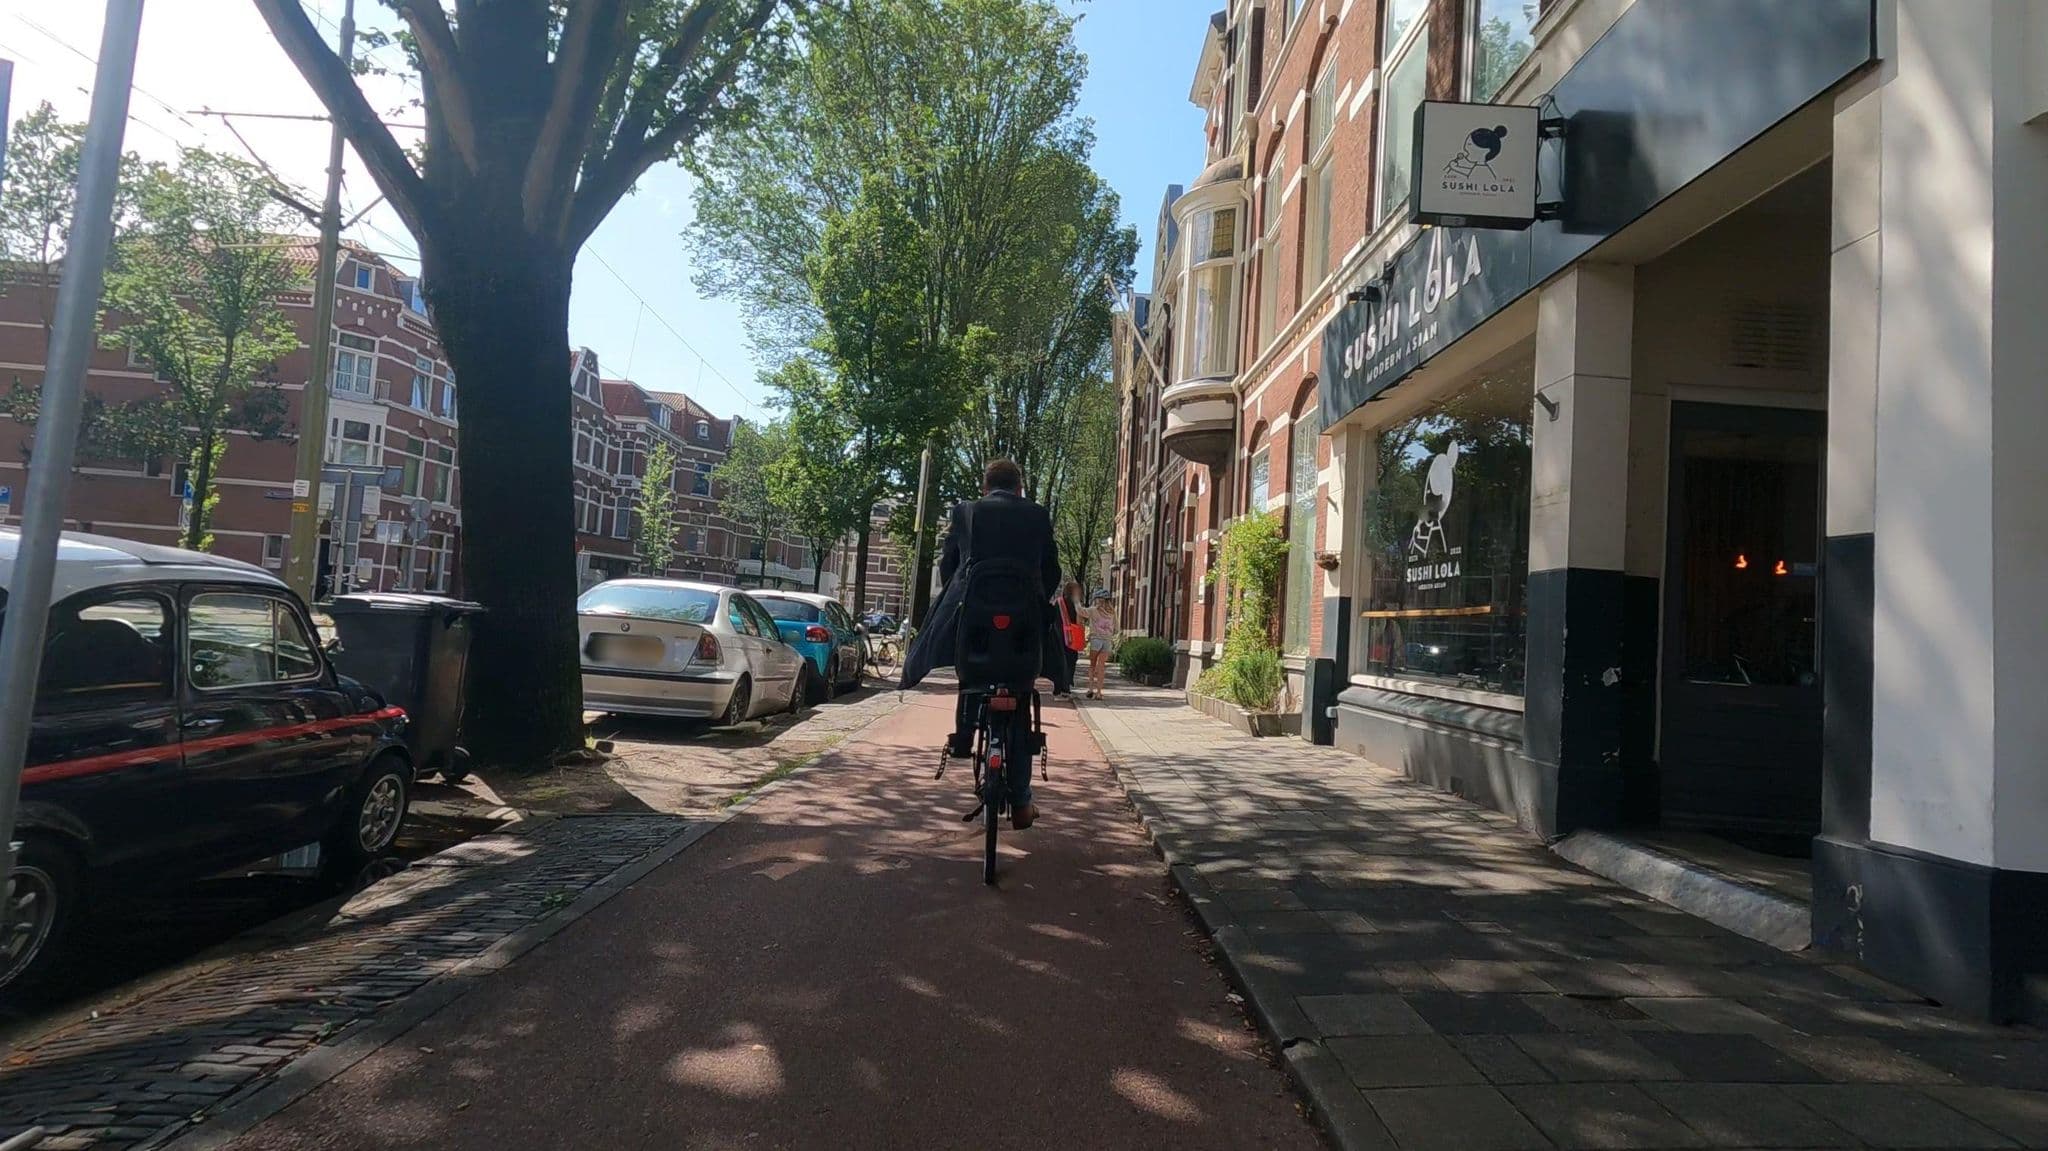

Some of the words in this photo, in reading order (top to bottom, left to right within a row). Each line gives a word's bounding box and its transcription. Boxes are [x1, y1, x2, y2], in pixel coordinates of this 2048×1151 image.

[1442, 181, 1478, 191] SUSHI
[1483, 183, 1515, 193] LOLA
[1344, 302, 1399, 379] SUSHI
[1408, 229, 1482, 328] LOLA
[1366, 347, 1402, 384] MODERN
[1406, 321, 1438, 356] ASIAN
[1406, 565, 1432, 583] SUSHI
[1435, 560, 1461, 579] LOLA
